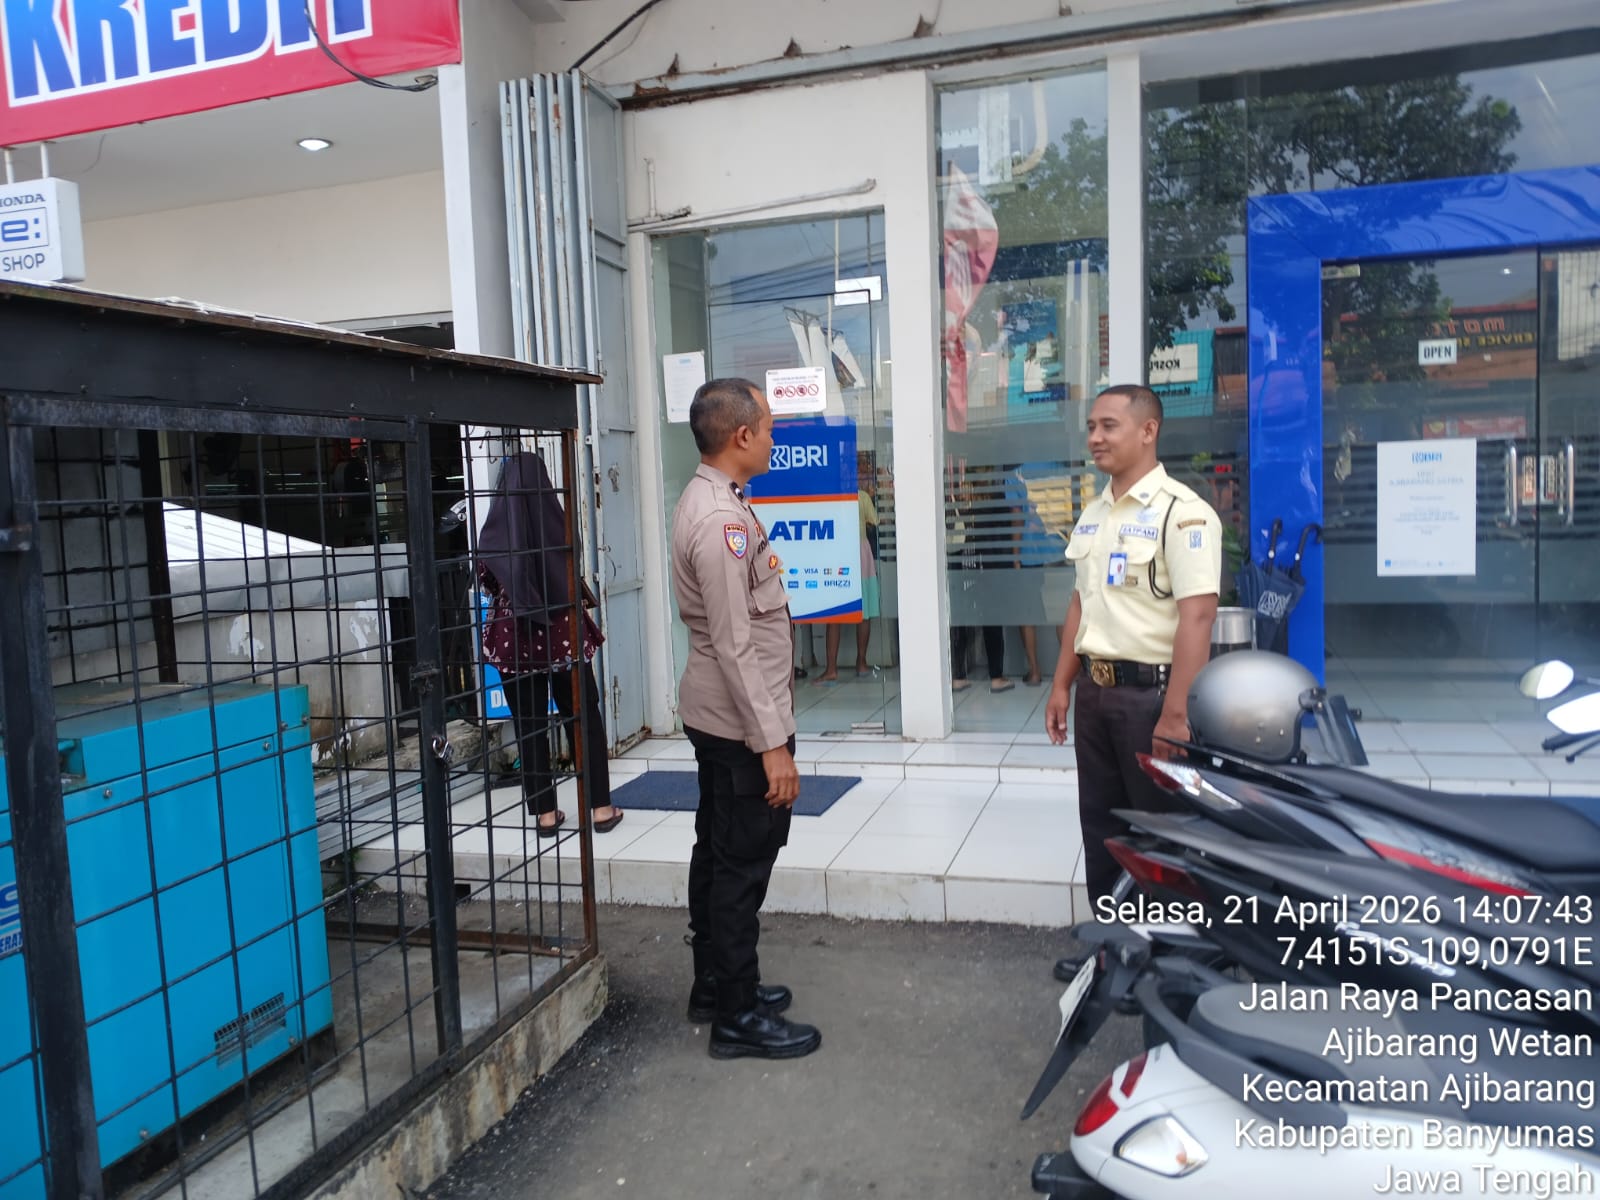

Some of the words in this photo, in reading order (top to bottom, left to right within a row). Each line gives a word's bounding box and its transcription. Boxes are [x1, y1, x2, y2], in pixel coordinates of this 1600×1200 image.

[2, 253, 46, 272] SHOP
[1423, 345, 1452, 359] OPEN
[792, 444, 828, 467] BRI
[768, 520, 834, 541] ATM
